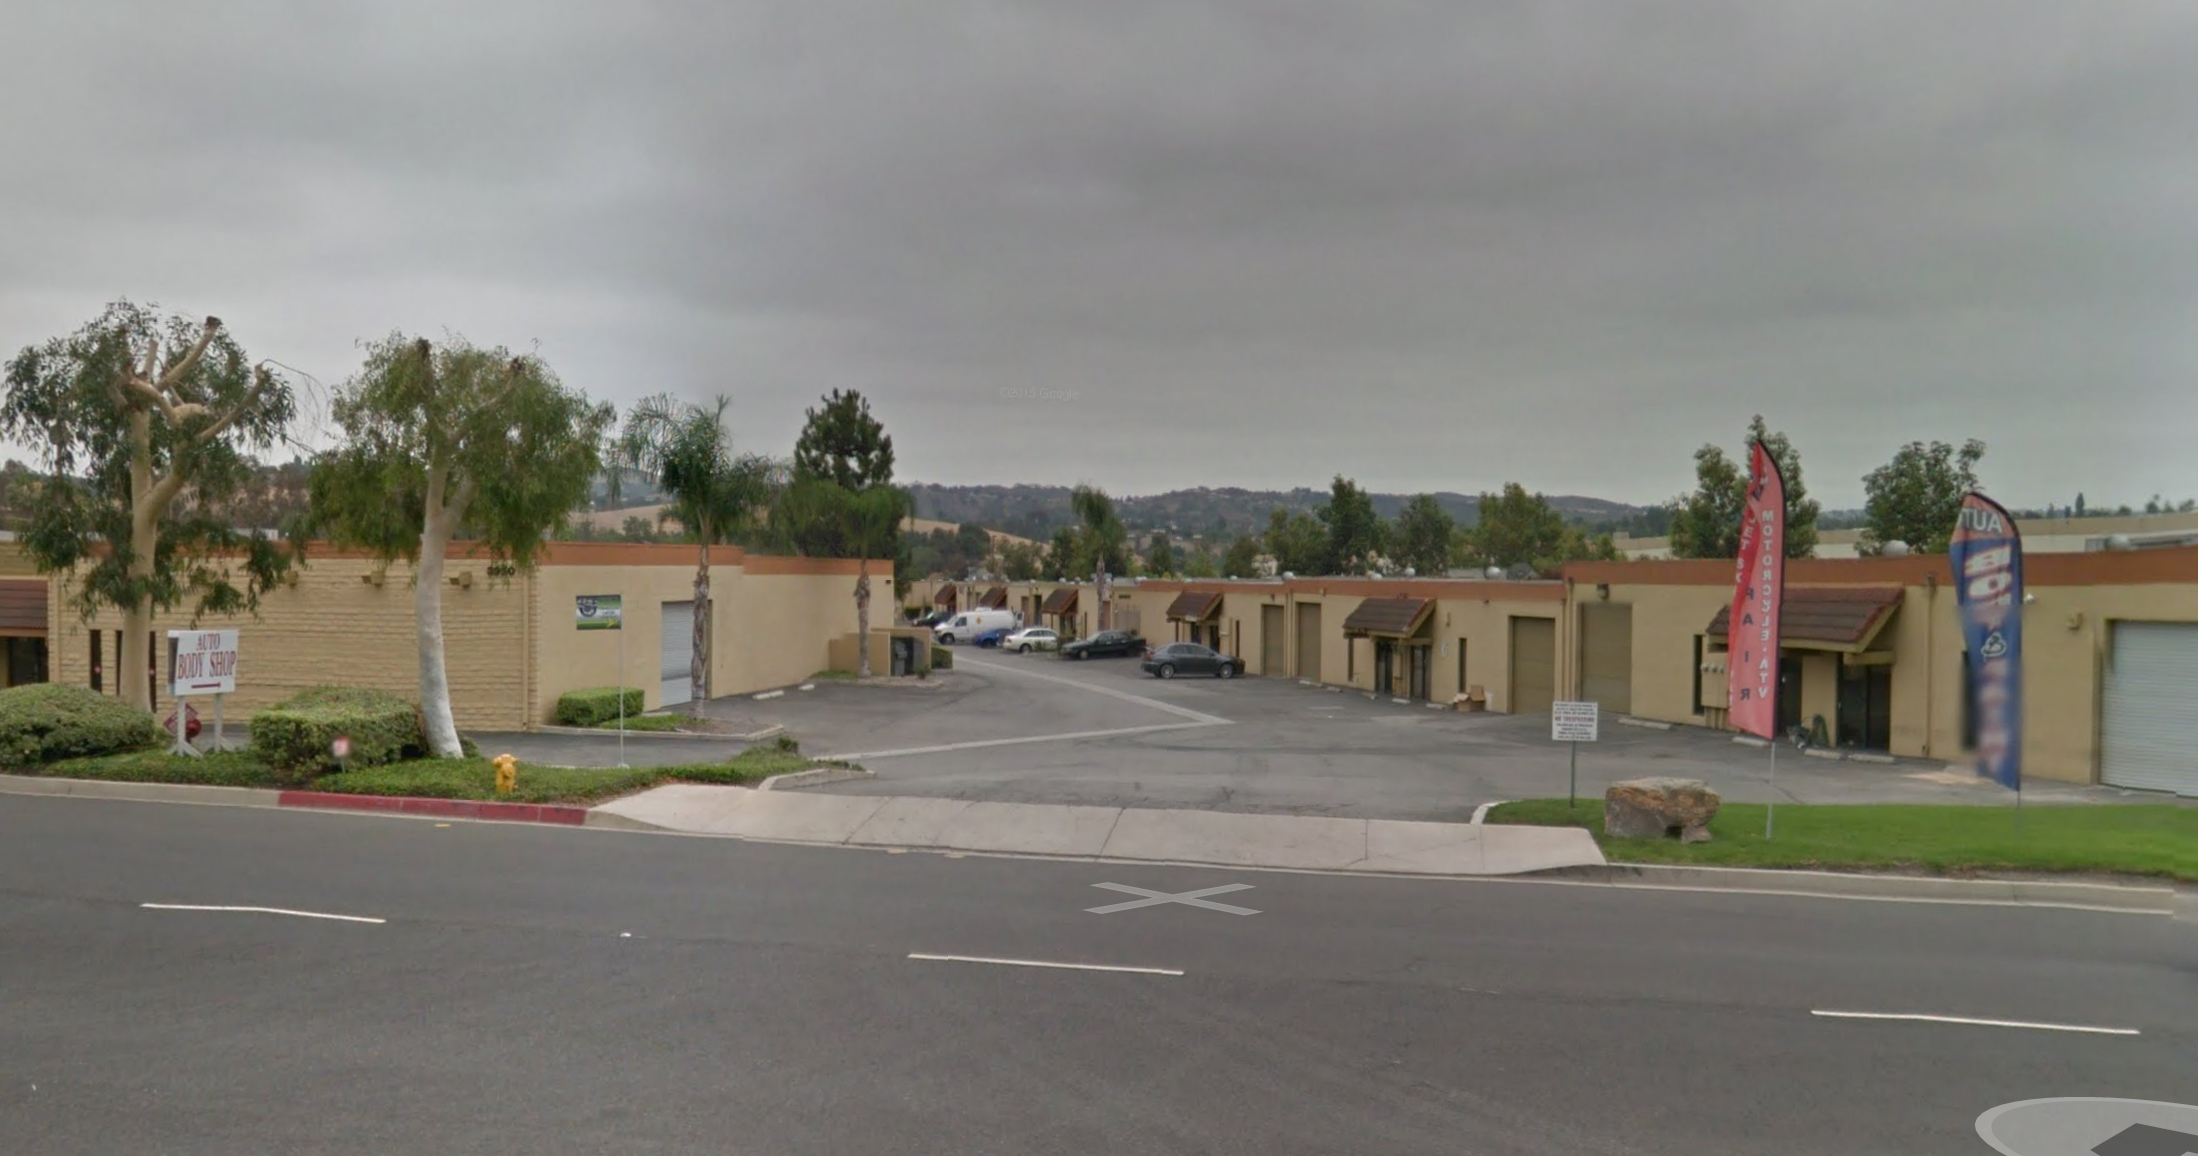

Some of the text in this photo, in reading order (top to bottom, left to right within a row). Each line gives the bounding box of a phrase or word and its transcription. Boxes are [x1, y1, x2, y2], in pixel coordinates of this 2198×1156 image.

[196, 633, 221, 651] AUTO
[178, 650, 237, 680] BODY SHOP
